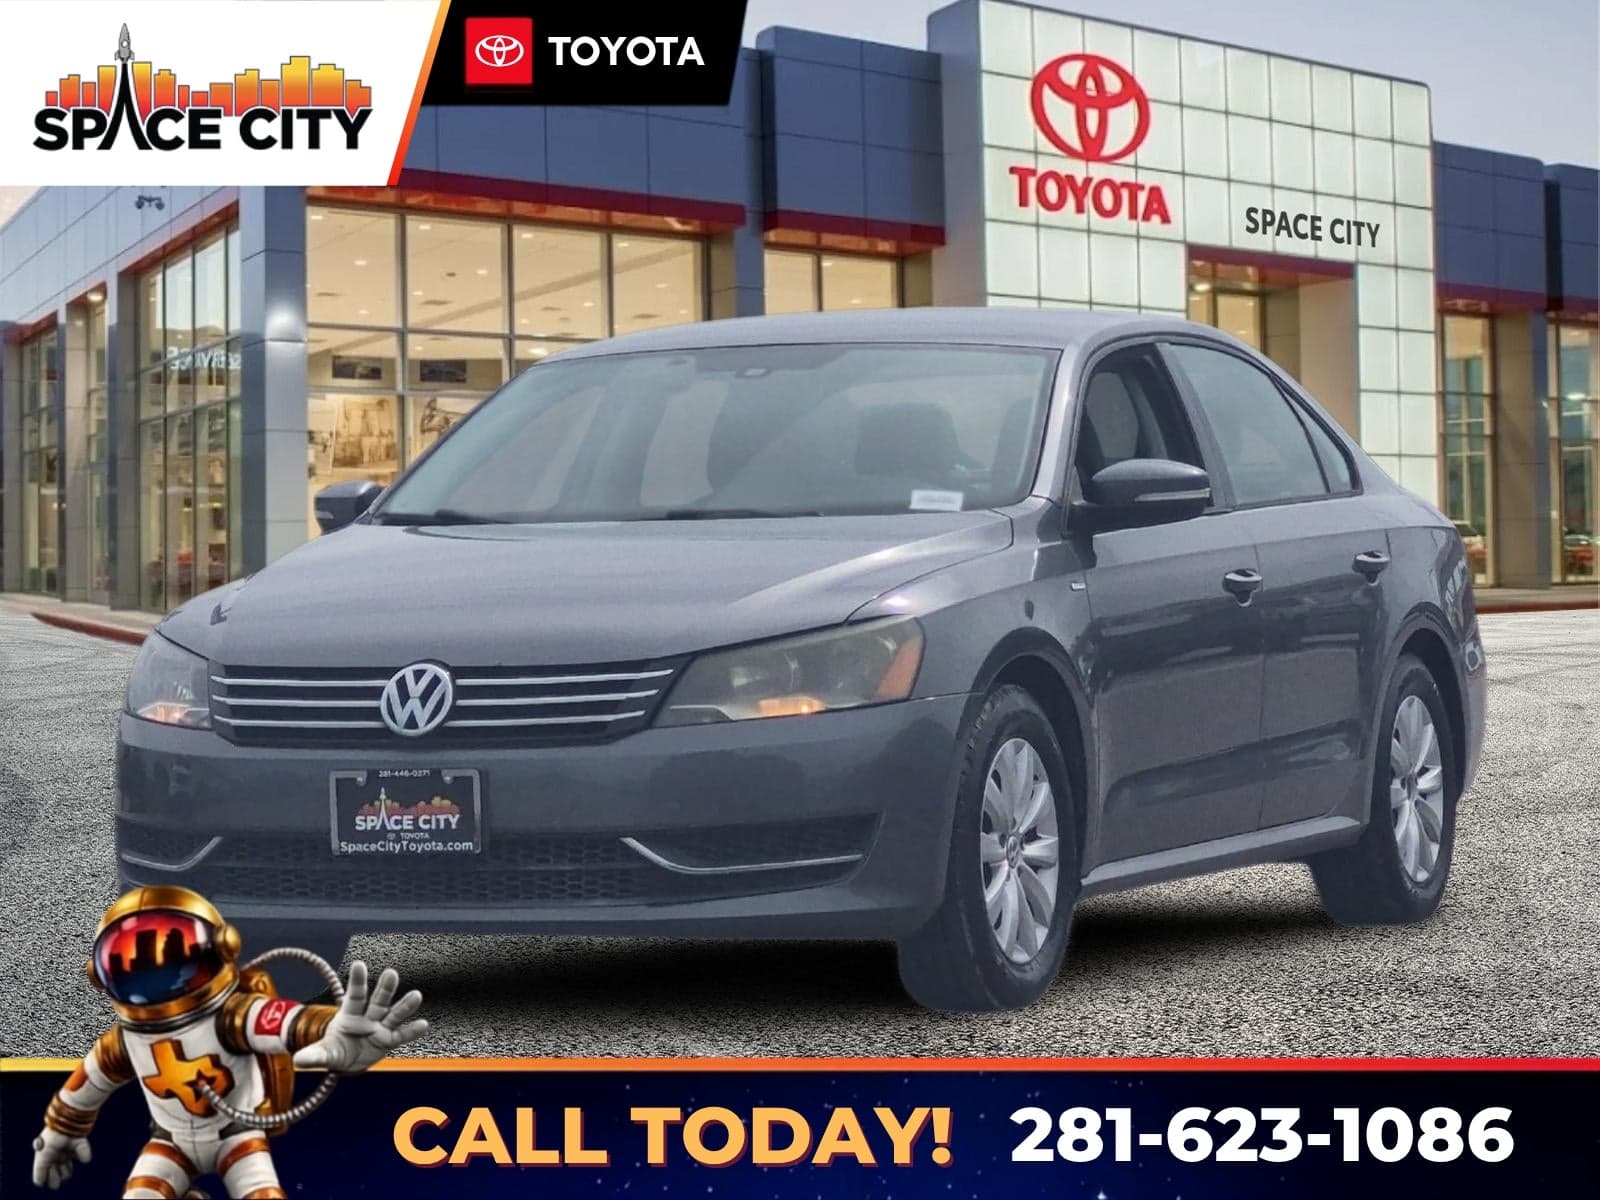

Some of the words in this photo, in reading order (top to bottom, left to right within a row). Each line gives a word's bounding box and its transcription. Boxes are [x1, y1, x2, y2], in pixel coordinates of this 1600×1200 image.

[1009, 166, 1172, 225] TOYOTA
[1245, 207, 1323, 242] SPACE
[1329, 218, 1381, 249] CITY
[355, 812, 414, 831] SPACE
[418, 814, 460, 831] CITY
[400, 832, 430, 840] TOYOTA
[340, 841, 473, 854] SpaceCityToyota.com
